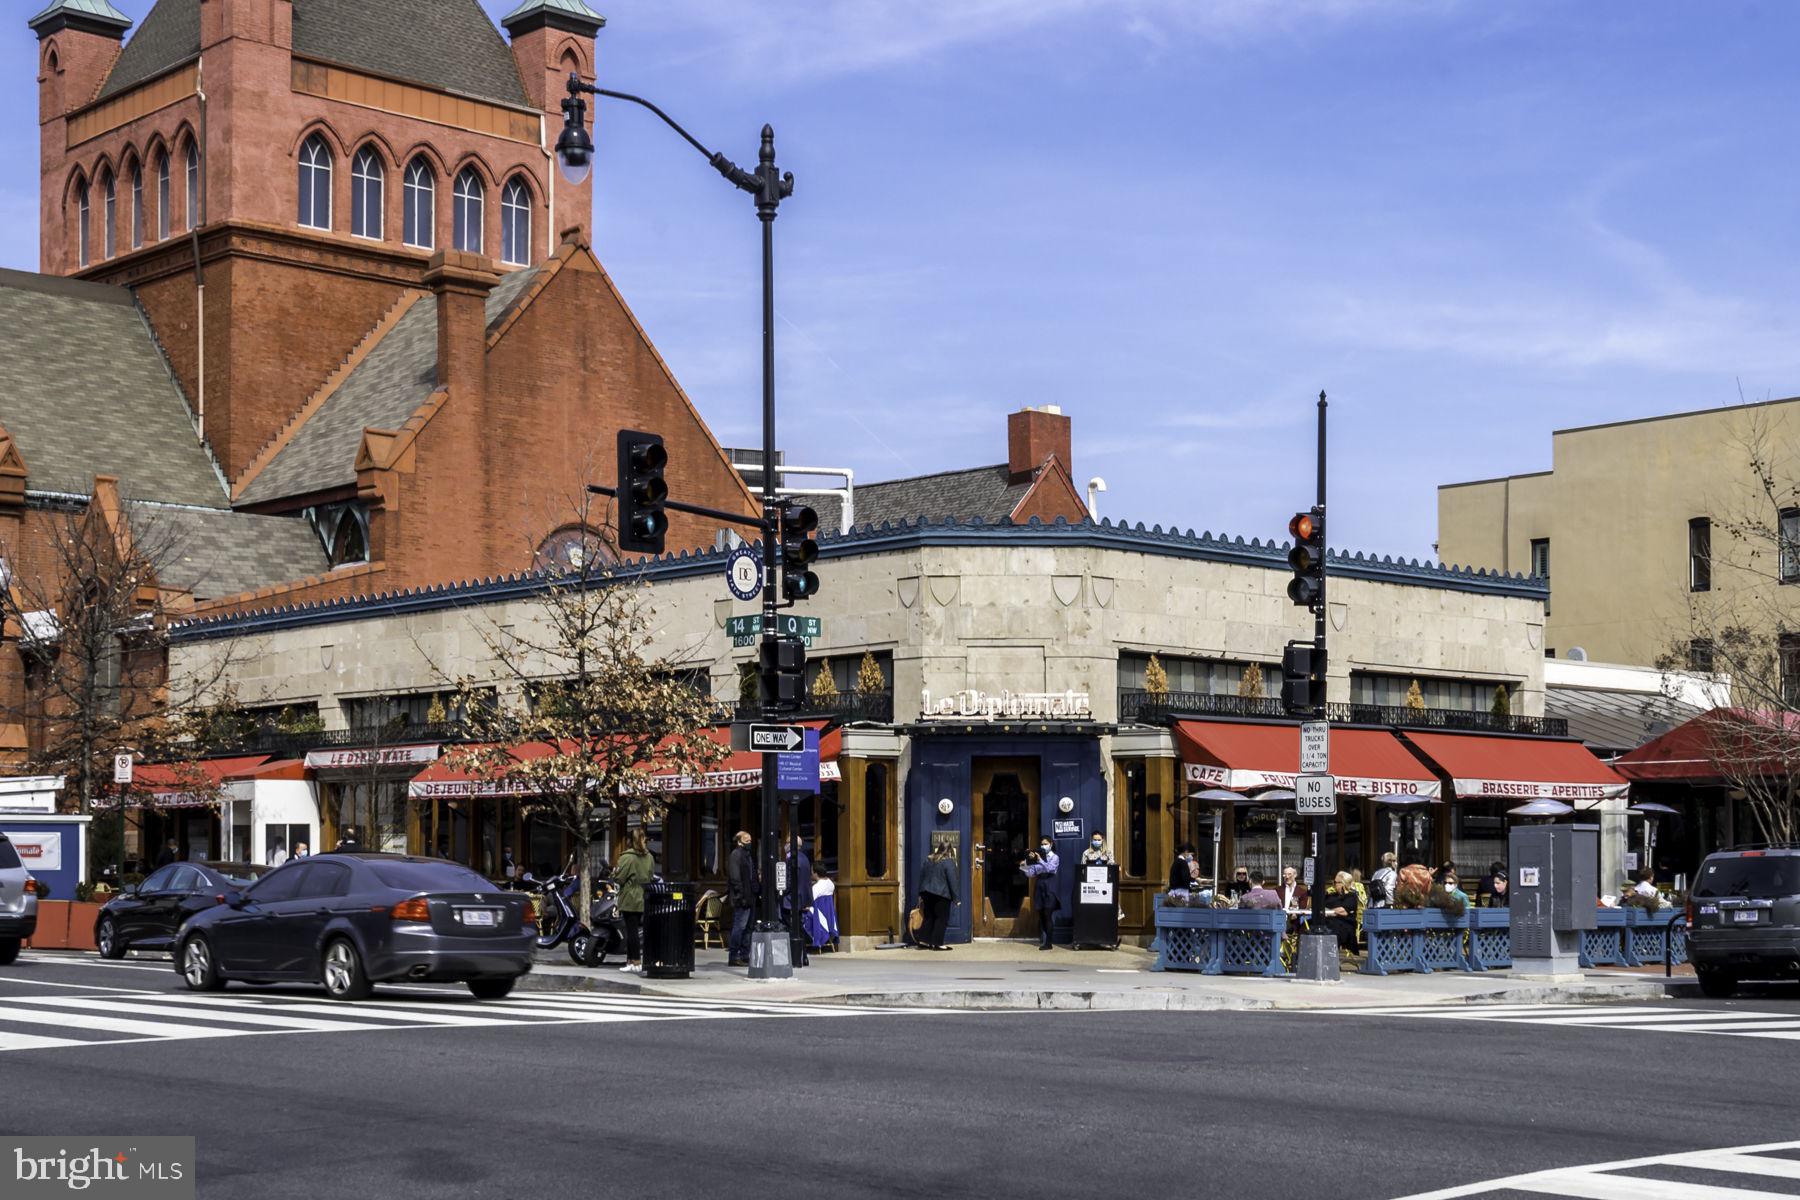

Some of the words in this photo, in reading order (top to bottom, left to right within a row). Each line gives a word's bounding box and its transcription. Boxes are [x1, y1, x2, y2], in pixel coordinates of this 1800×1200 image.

[731, 549, 758, 563] GREATER
[739, 567, 752, 581] DC
[741, 582, 761, 600] STREET
[732, 618, 745, 634] 14
[752, 616, 760, 624] ST
[788, 617, 797, 633] Q
[808, 619, 817, 627] ST
[807, 626, 818, 634] NW
[734, 635, 755, 647] 1600
[921, 689, 954, 716] Le
[956, 689, 1090, 723] Diplomate
[755, 732, 771, 743] ONE
[772, 733, 788, 744] WAY
[330, 753, 345, 764] LE
[1191, 766, 1225, 783] CAFE
[1260, 773, 1297, 787] FRUIT
[1371, 780, 1418, 795] BISTRO
[1308, 781, 1321, 793] NO
[1482, 782, 1540, 796] BRASSERIE
[1551, 785, 1606, 798] APERITIFS
[1299, 796, 1332, 808] BUSES
